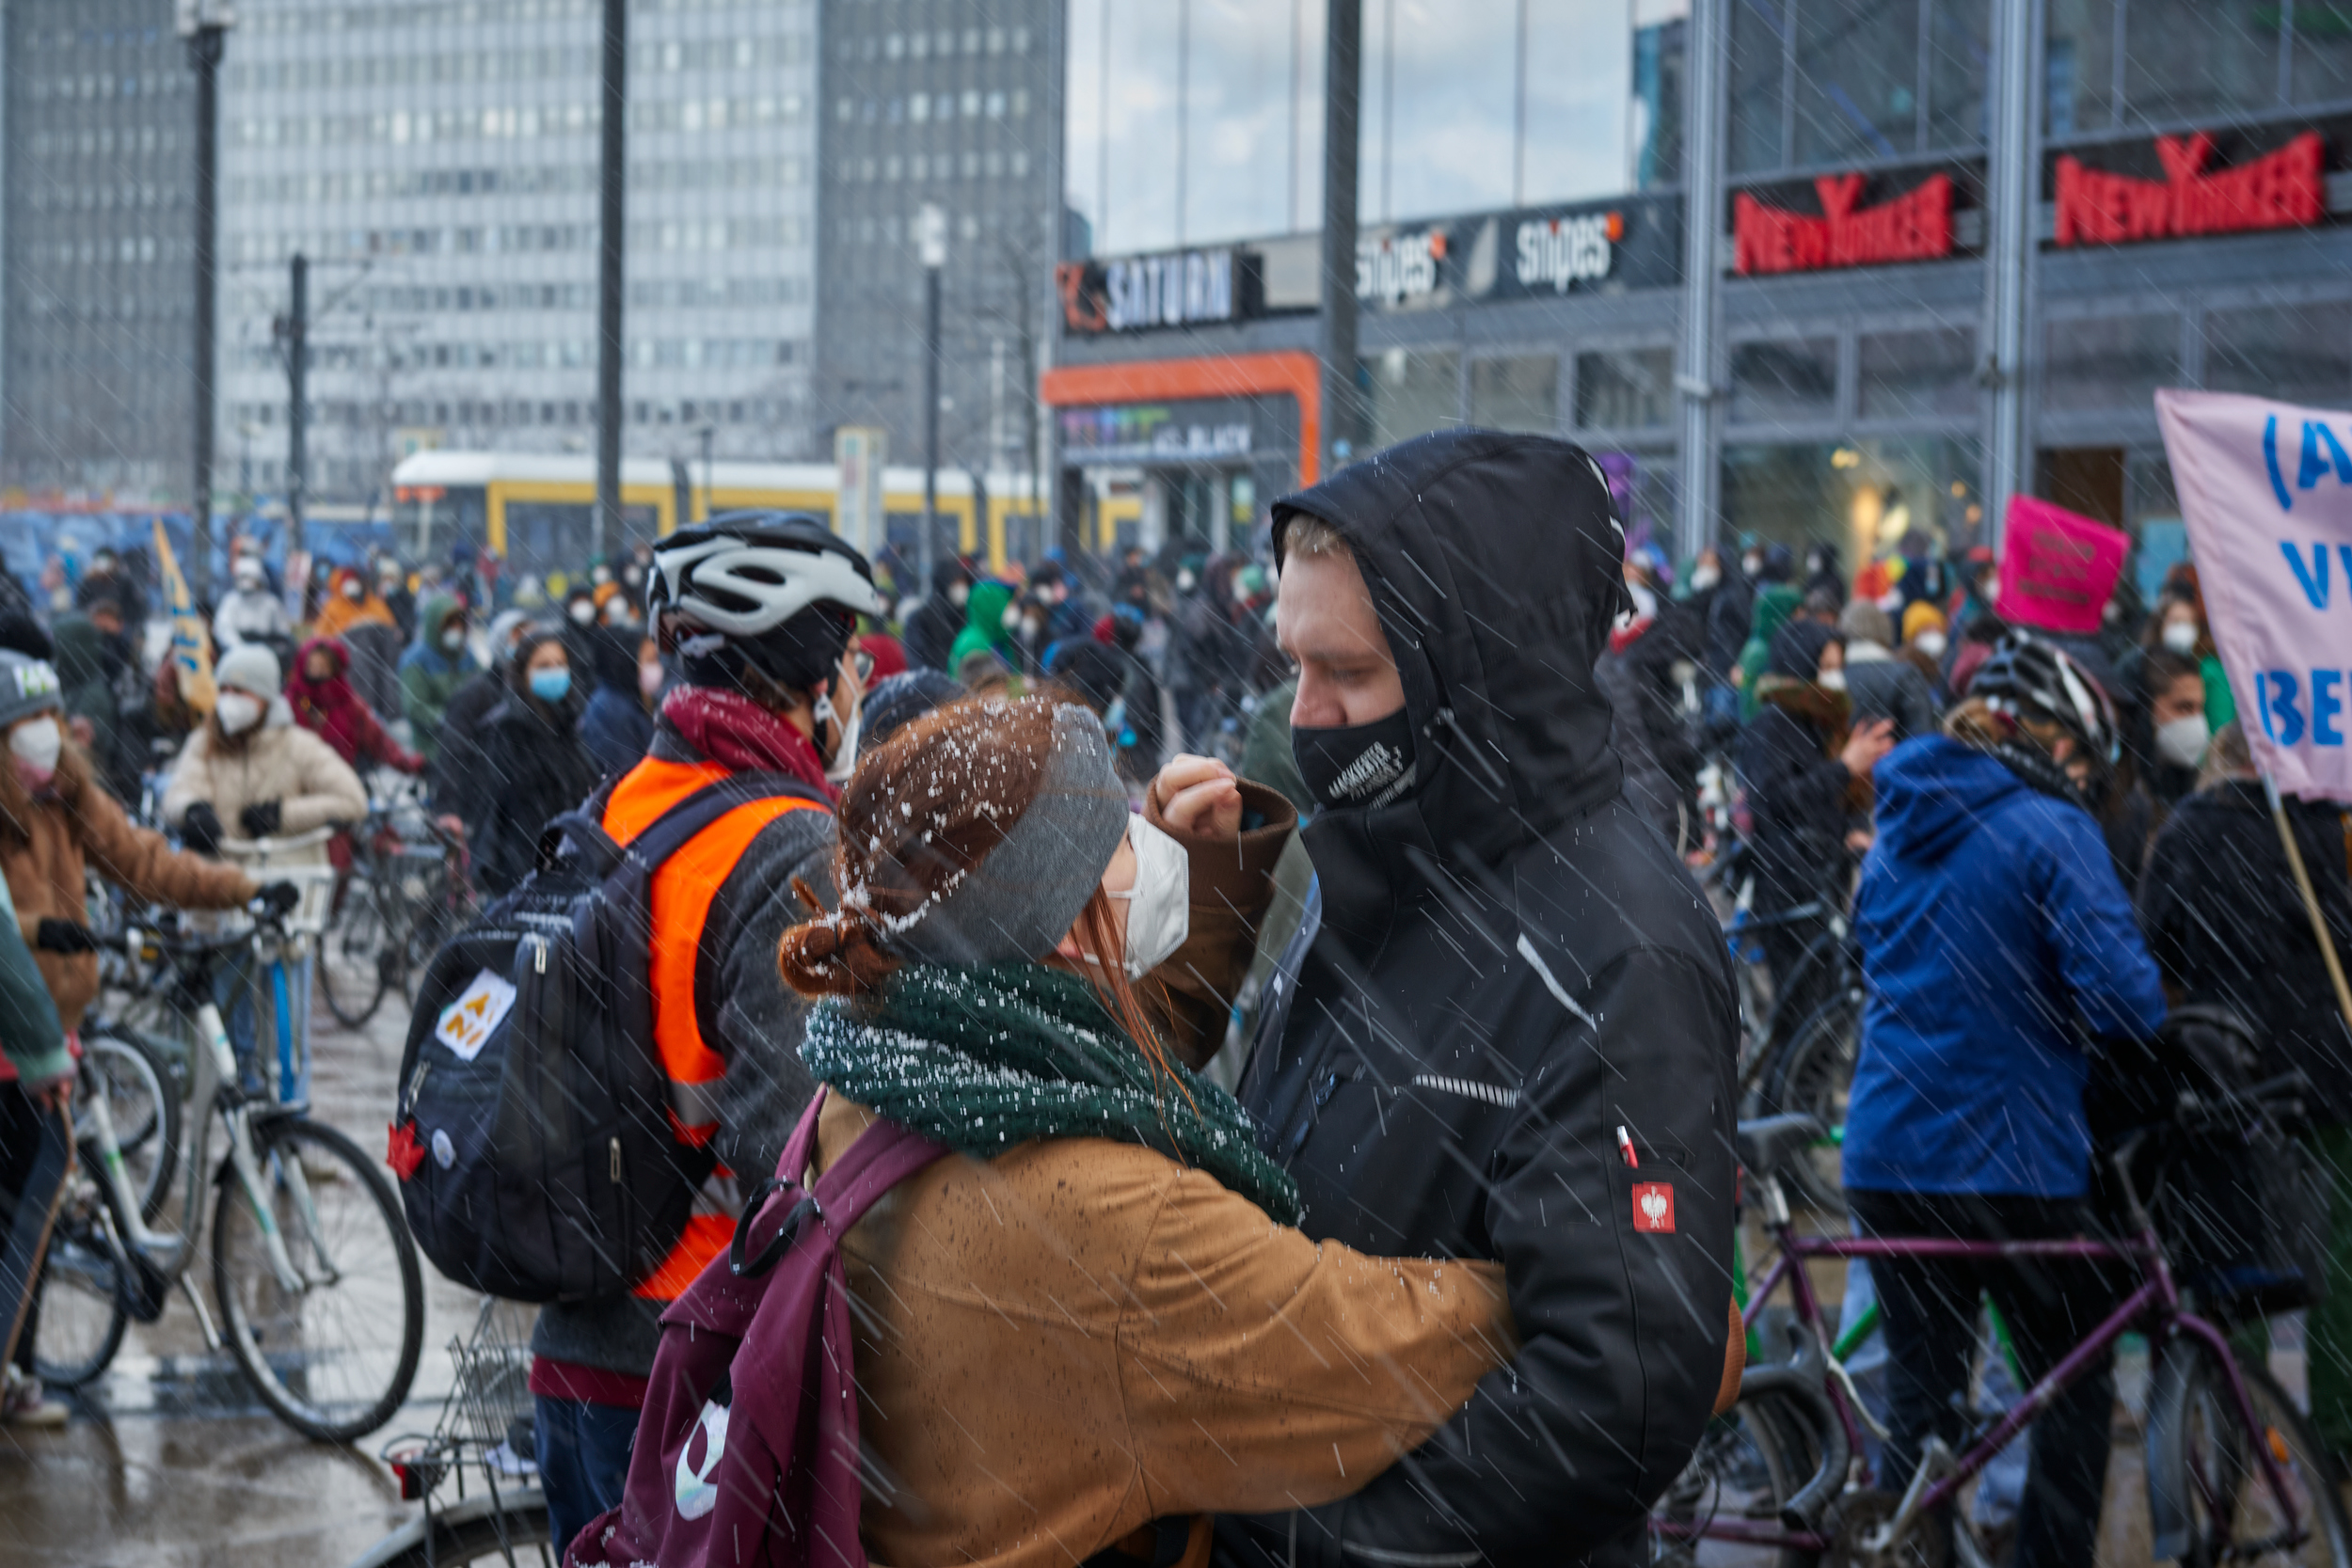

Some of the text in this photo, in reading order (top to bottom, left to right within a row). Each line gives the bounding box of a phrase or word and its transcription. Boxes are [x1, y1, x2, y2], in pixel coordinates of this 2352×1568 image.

[1105, 249, 1232, 331] SATURN
[1516, 213, 1612, 294] snipes
[2264, 414, 2352, 513] (A
[2255, 669, 2352, 747] BE
